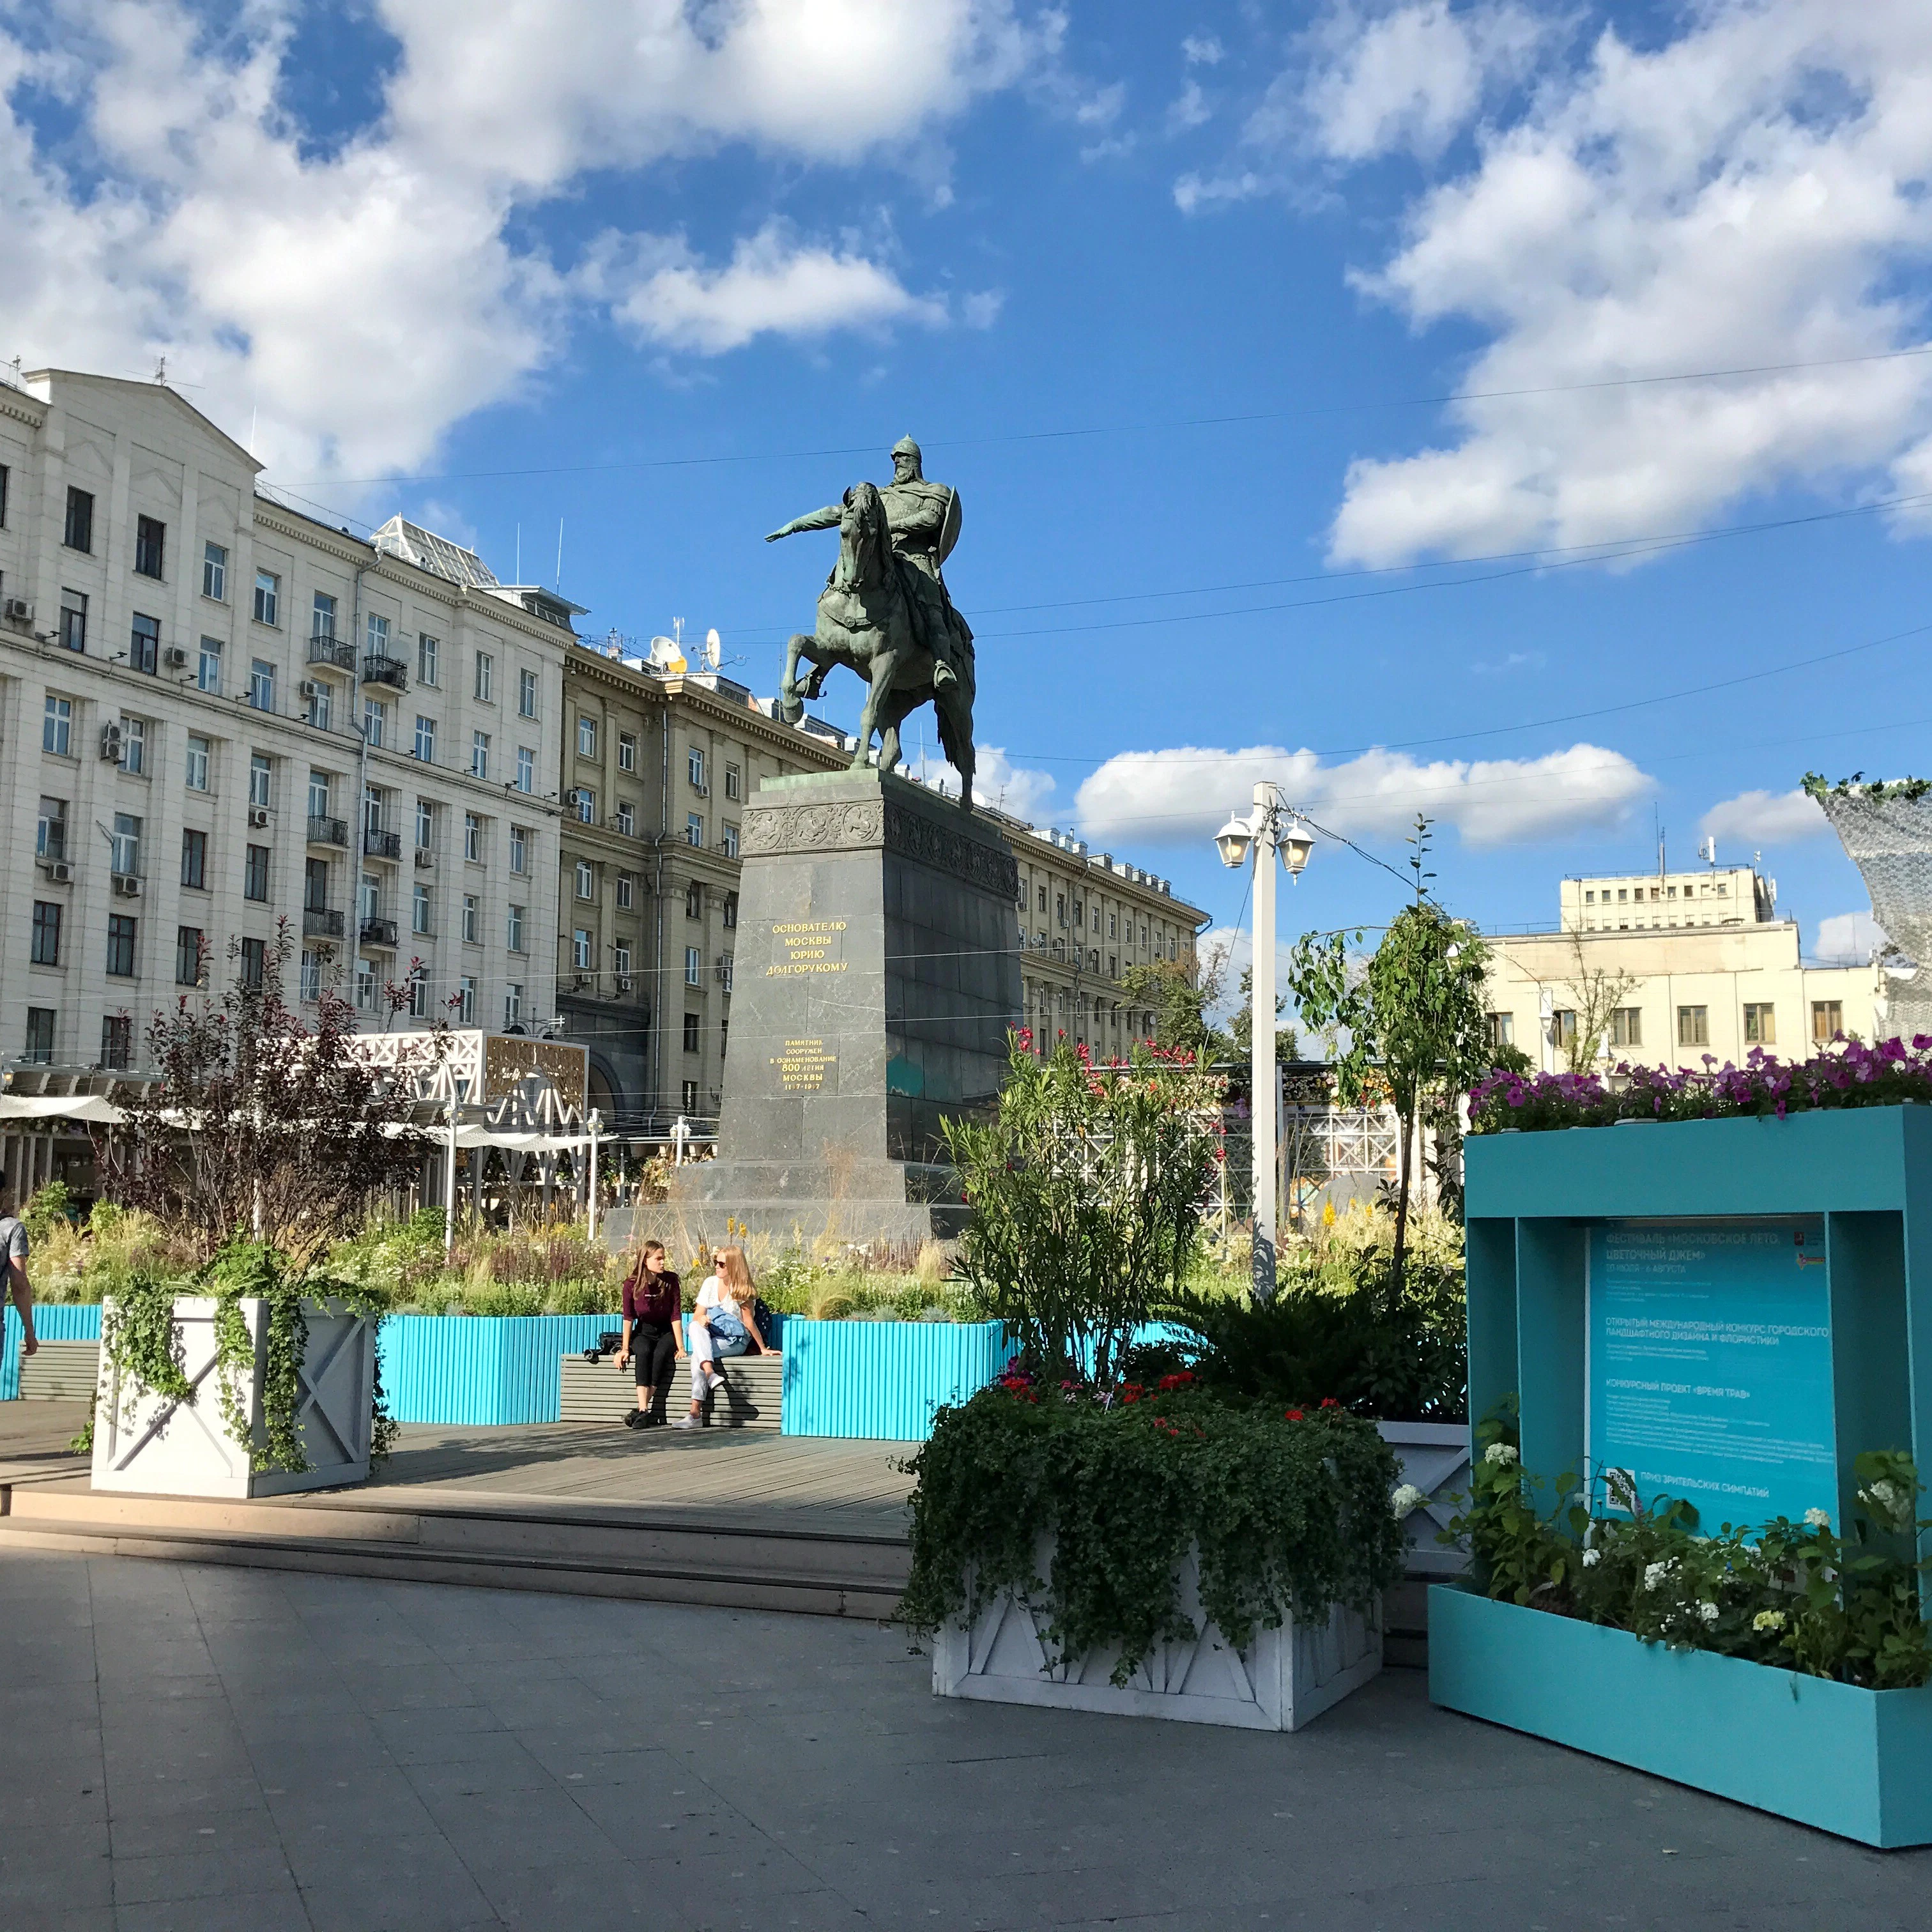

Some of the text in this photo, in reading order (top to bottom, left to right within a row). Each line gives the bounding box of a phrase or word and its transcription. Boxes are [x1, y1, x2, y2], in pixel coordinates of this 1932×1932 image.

[772, 922, 847, 933] ОСНОВАТЕЛЮ
[785, 936, 832, 947] МОСКВЫ
[790, 950, 825, 960] ЮРИЮ
[766, 963, 848, 976] ДОЛГОРУКОМУ
[781, 1064, 801, 1072] 800
[1606, 1234, 1665, 1245] ФЕСТИВАЛЬ
[1606, 1248, 1666, 1261] ЦВЕТОЧНЫЙ
[1606, 1317, 1828, 1337] ОТКРЫТЫЙ МЕЖДУНАРОДНЫЙ КОНКУРС ГОРОДСКОГО
[1606, 1328, 1669, 1339] ЛАНДШАФТНОГО
[1720, 1335, 1779, 1345] ФЛОРИСТИКИ
[1606, 1379, 1659, 1390] КОНКУРСНЫЙ
[1661, 1383, 1690, 1393] ПРОЕКТ
[1664, 1475, 1720, 1491] ЗРИТЕЛЬСКИХ
[1721, 1483, 1770, 1498] СИМПАТИЙ
